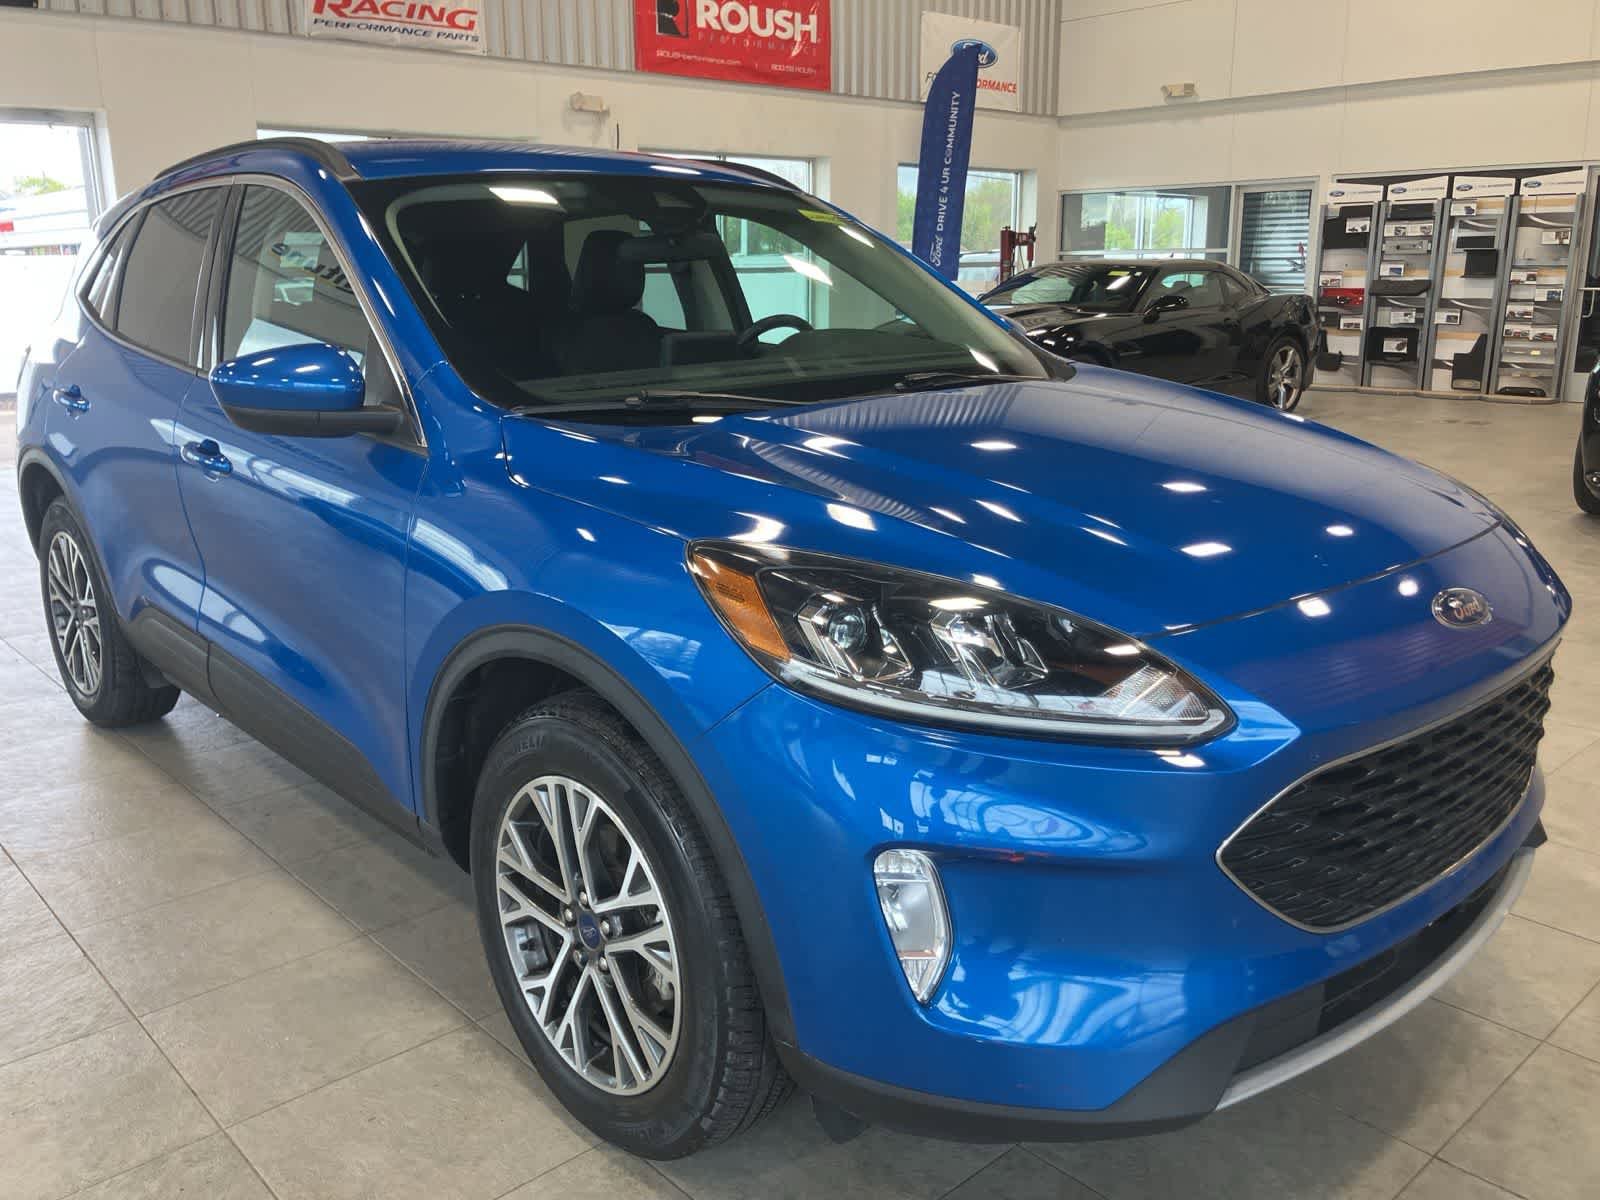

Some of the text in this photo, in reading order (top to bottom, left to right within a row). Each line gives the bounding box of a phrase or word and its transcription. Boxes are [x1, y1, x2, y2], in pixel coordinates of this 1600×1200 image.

[313, 0, 478, 30] RACING
[313, 17, 480, 42] PERFORMANCE PARTS
[696, 0, 818, 55] ROUSH
[976, 78, 1017, 94] ORMANCE
[929, 90, 961, 267] Ford DRIVE 4 UR COMMUNITY
